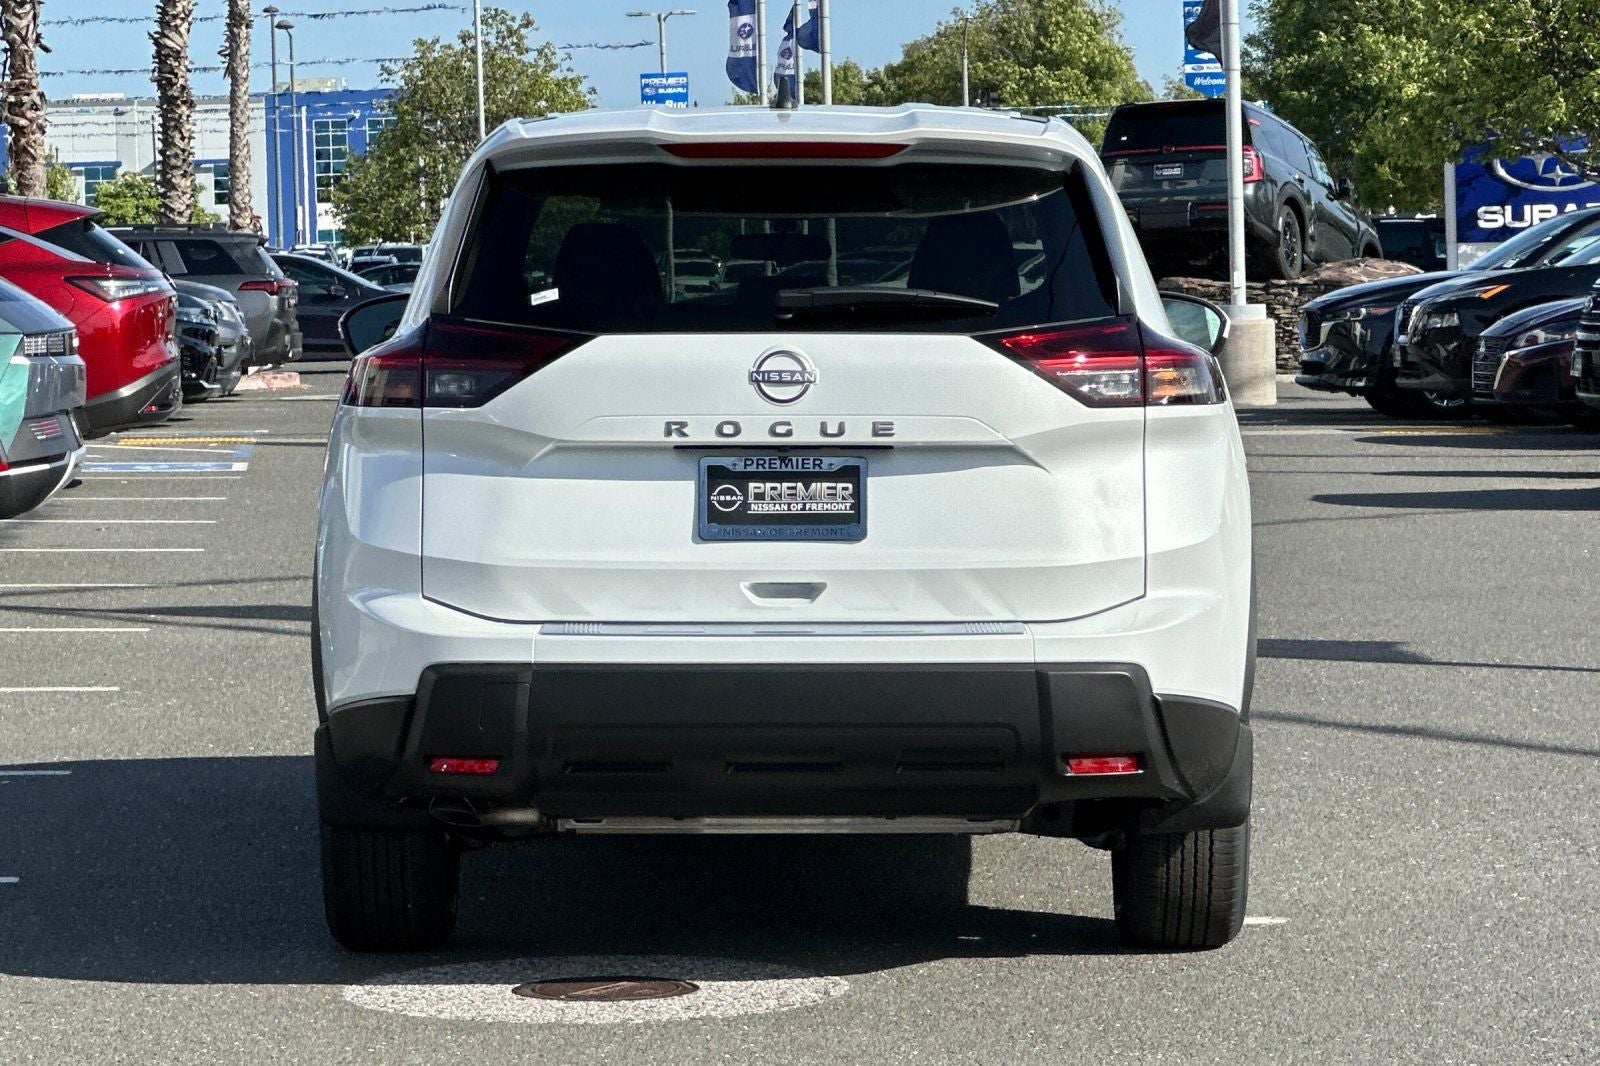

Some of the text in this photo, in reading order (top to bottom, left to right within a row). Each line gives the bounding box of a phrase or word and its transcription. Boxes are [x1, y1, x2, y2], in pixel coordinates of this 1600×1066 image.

[751, 371, 816, 381] NISSAN
[663, 420, 896, 438] ROGUE
[743, 457, 824, 470] PREMIER
[748, 482, 855, 501] PREMIER
[751, 502, 852, 511] NISSAN OF FREMONT
[722, 527, 845, 537] NISSAN OF FREMONT
